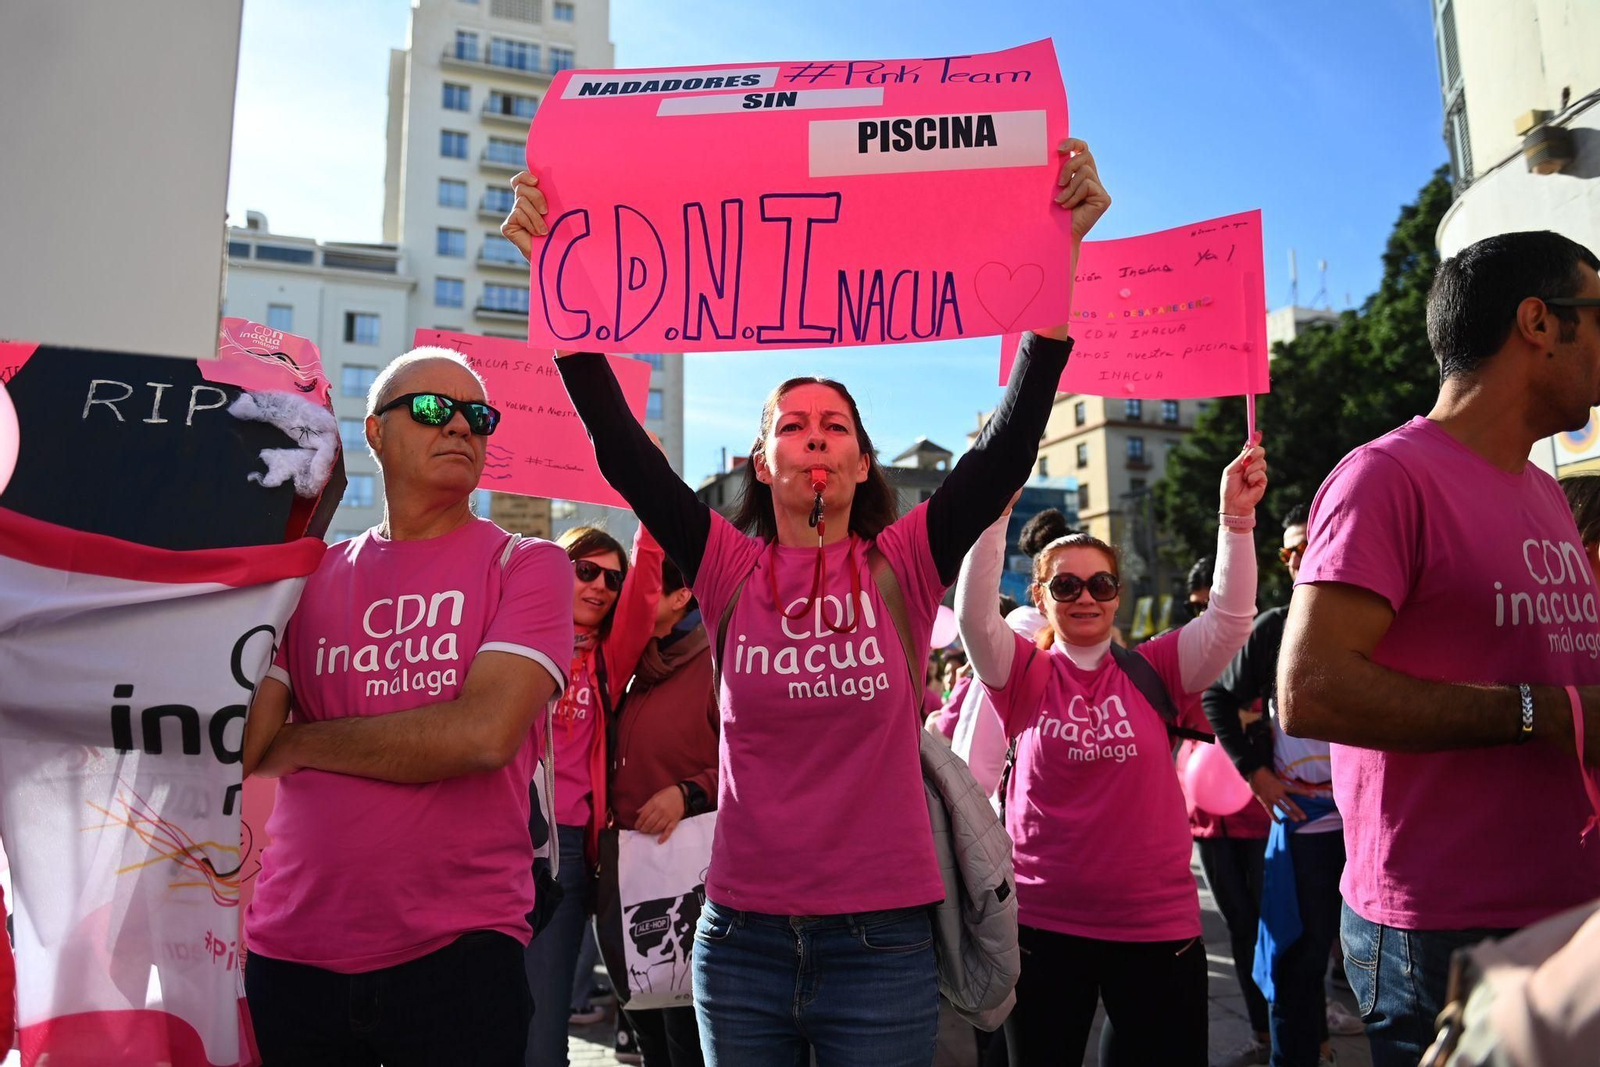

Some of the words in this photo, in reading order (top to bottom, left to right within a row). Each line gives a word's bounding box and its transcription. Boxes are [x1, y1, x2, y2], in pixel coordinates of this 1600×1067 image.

[931, 56, 1031, 83] Team
[578, 73, 761, 96] NADADORES
[742, 92, 797, 108] SIN
[858, 114, 997, 153] PISCINA
[81, 378, 228, 427] RIP
[1494, 581, 1599, 626] inacua
[315, 633, 459, 676] inacua
[735, 634, 884, 675] inacua
[366, 668, 457, 697] málaga
[788, 672, 890, 701] málaga
[638, 920, 667, 932] ALE-HOP
